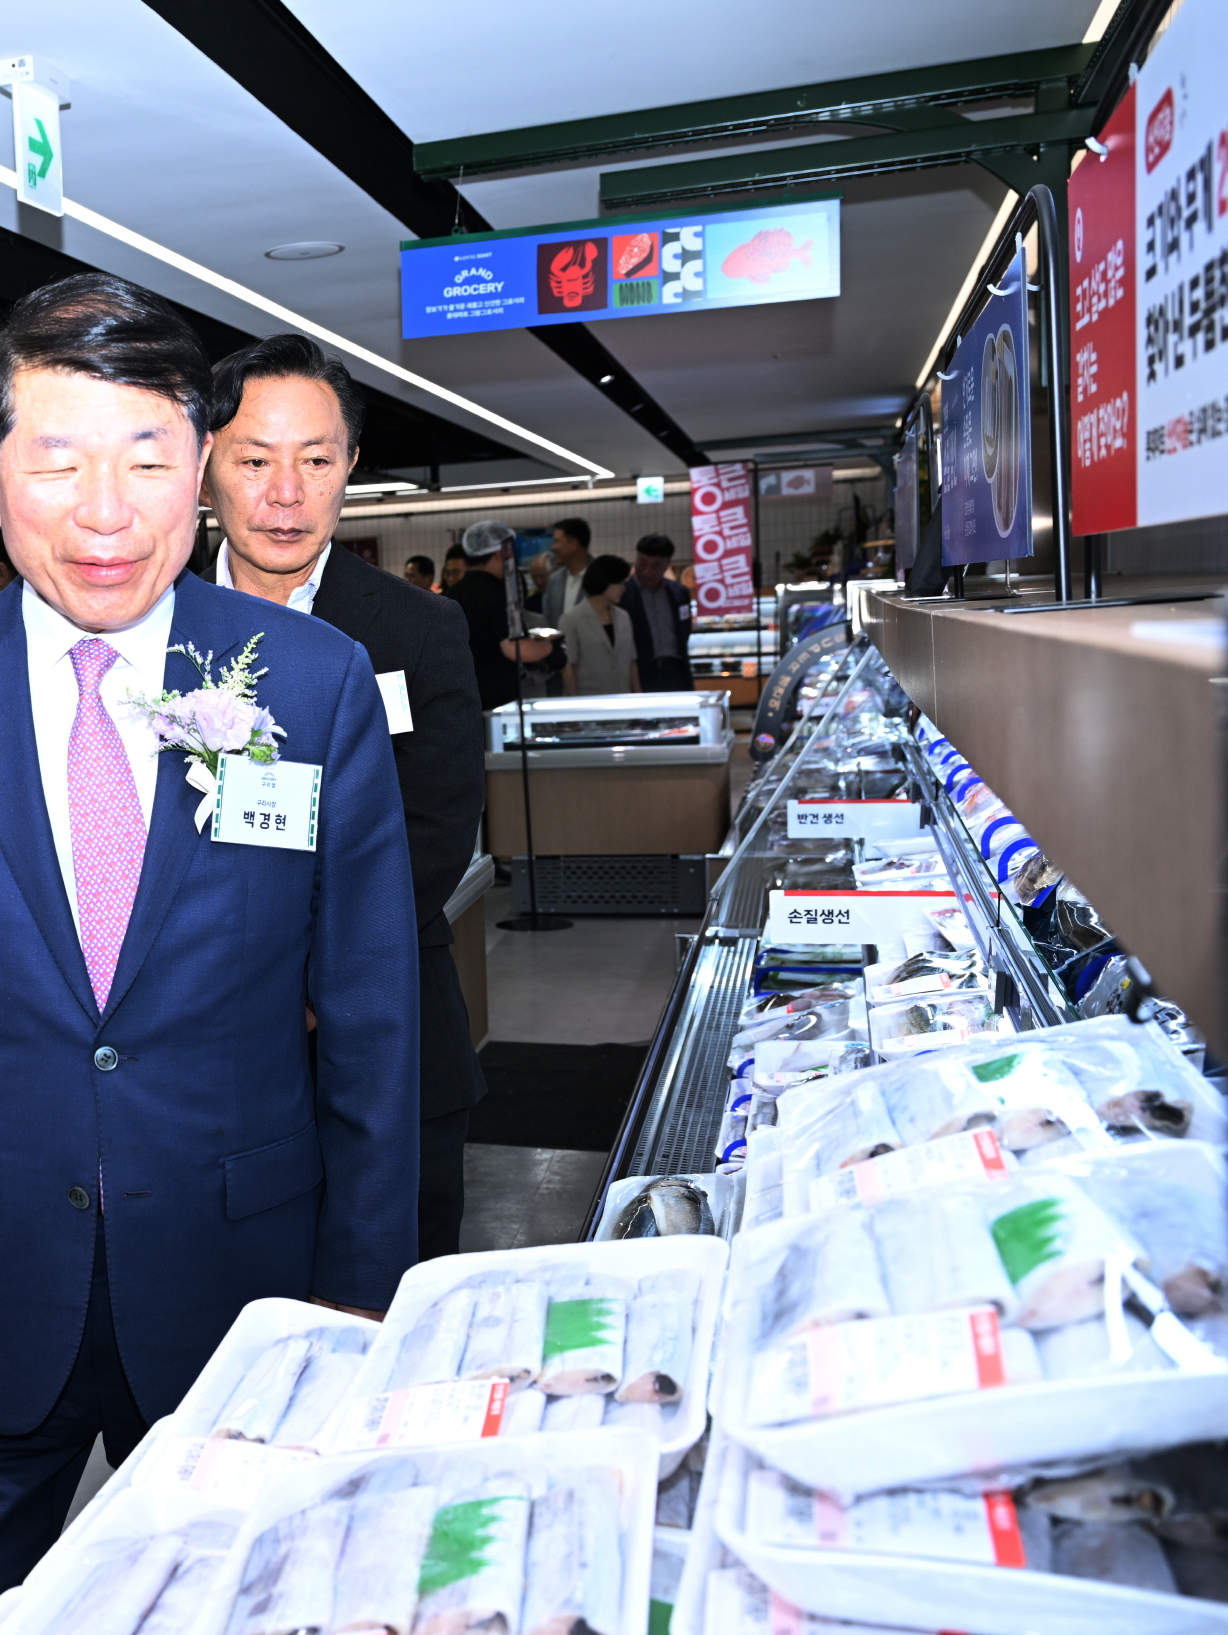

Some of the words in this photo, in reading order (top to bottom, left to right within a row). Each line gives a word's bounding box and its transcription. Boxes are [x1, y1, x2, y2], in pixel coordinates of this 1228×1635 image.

[1146, 175, 1181, 284] 크기와
[1184, 137, 1214, 253] 무게
[454, 267, 493, 284] GRAND
[443, 281, 504, 298] GROCERY
[1075, 277, 1090, 331] 크고
[1090, 259, 1106, 323] 살도
[257, 799, 277, 808] 구리시장
[243, 810, 287, 832] 백경현
[797, 813, 819, 826] 반건
[822, 812, 845, 825] 생선
[787, 909, 851, 925] 손질생선
